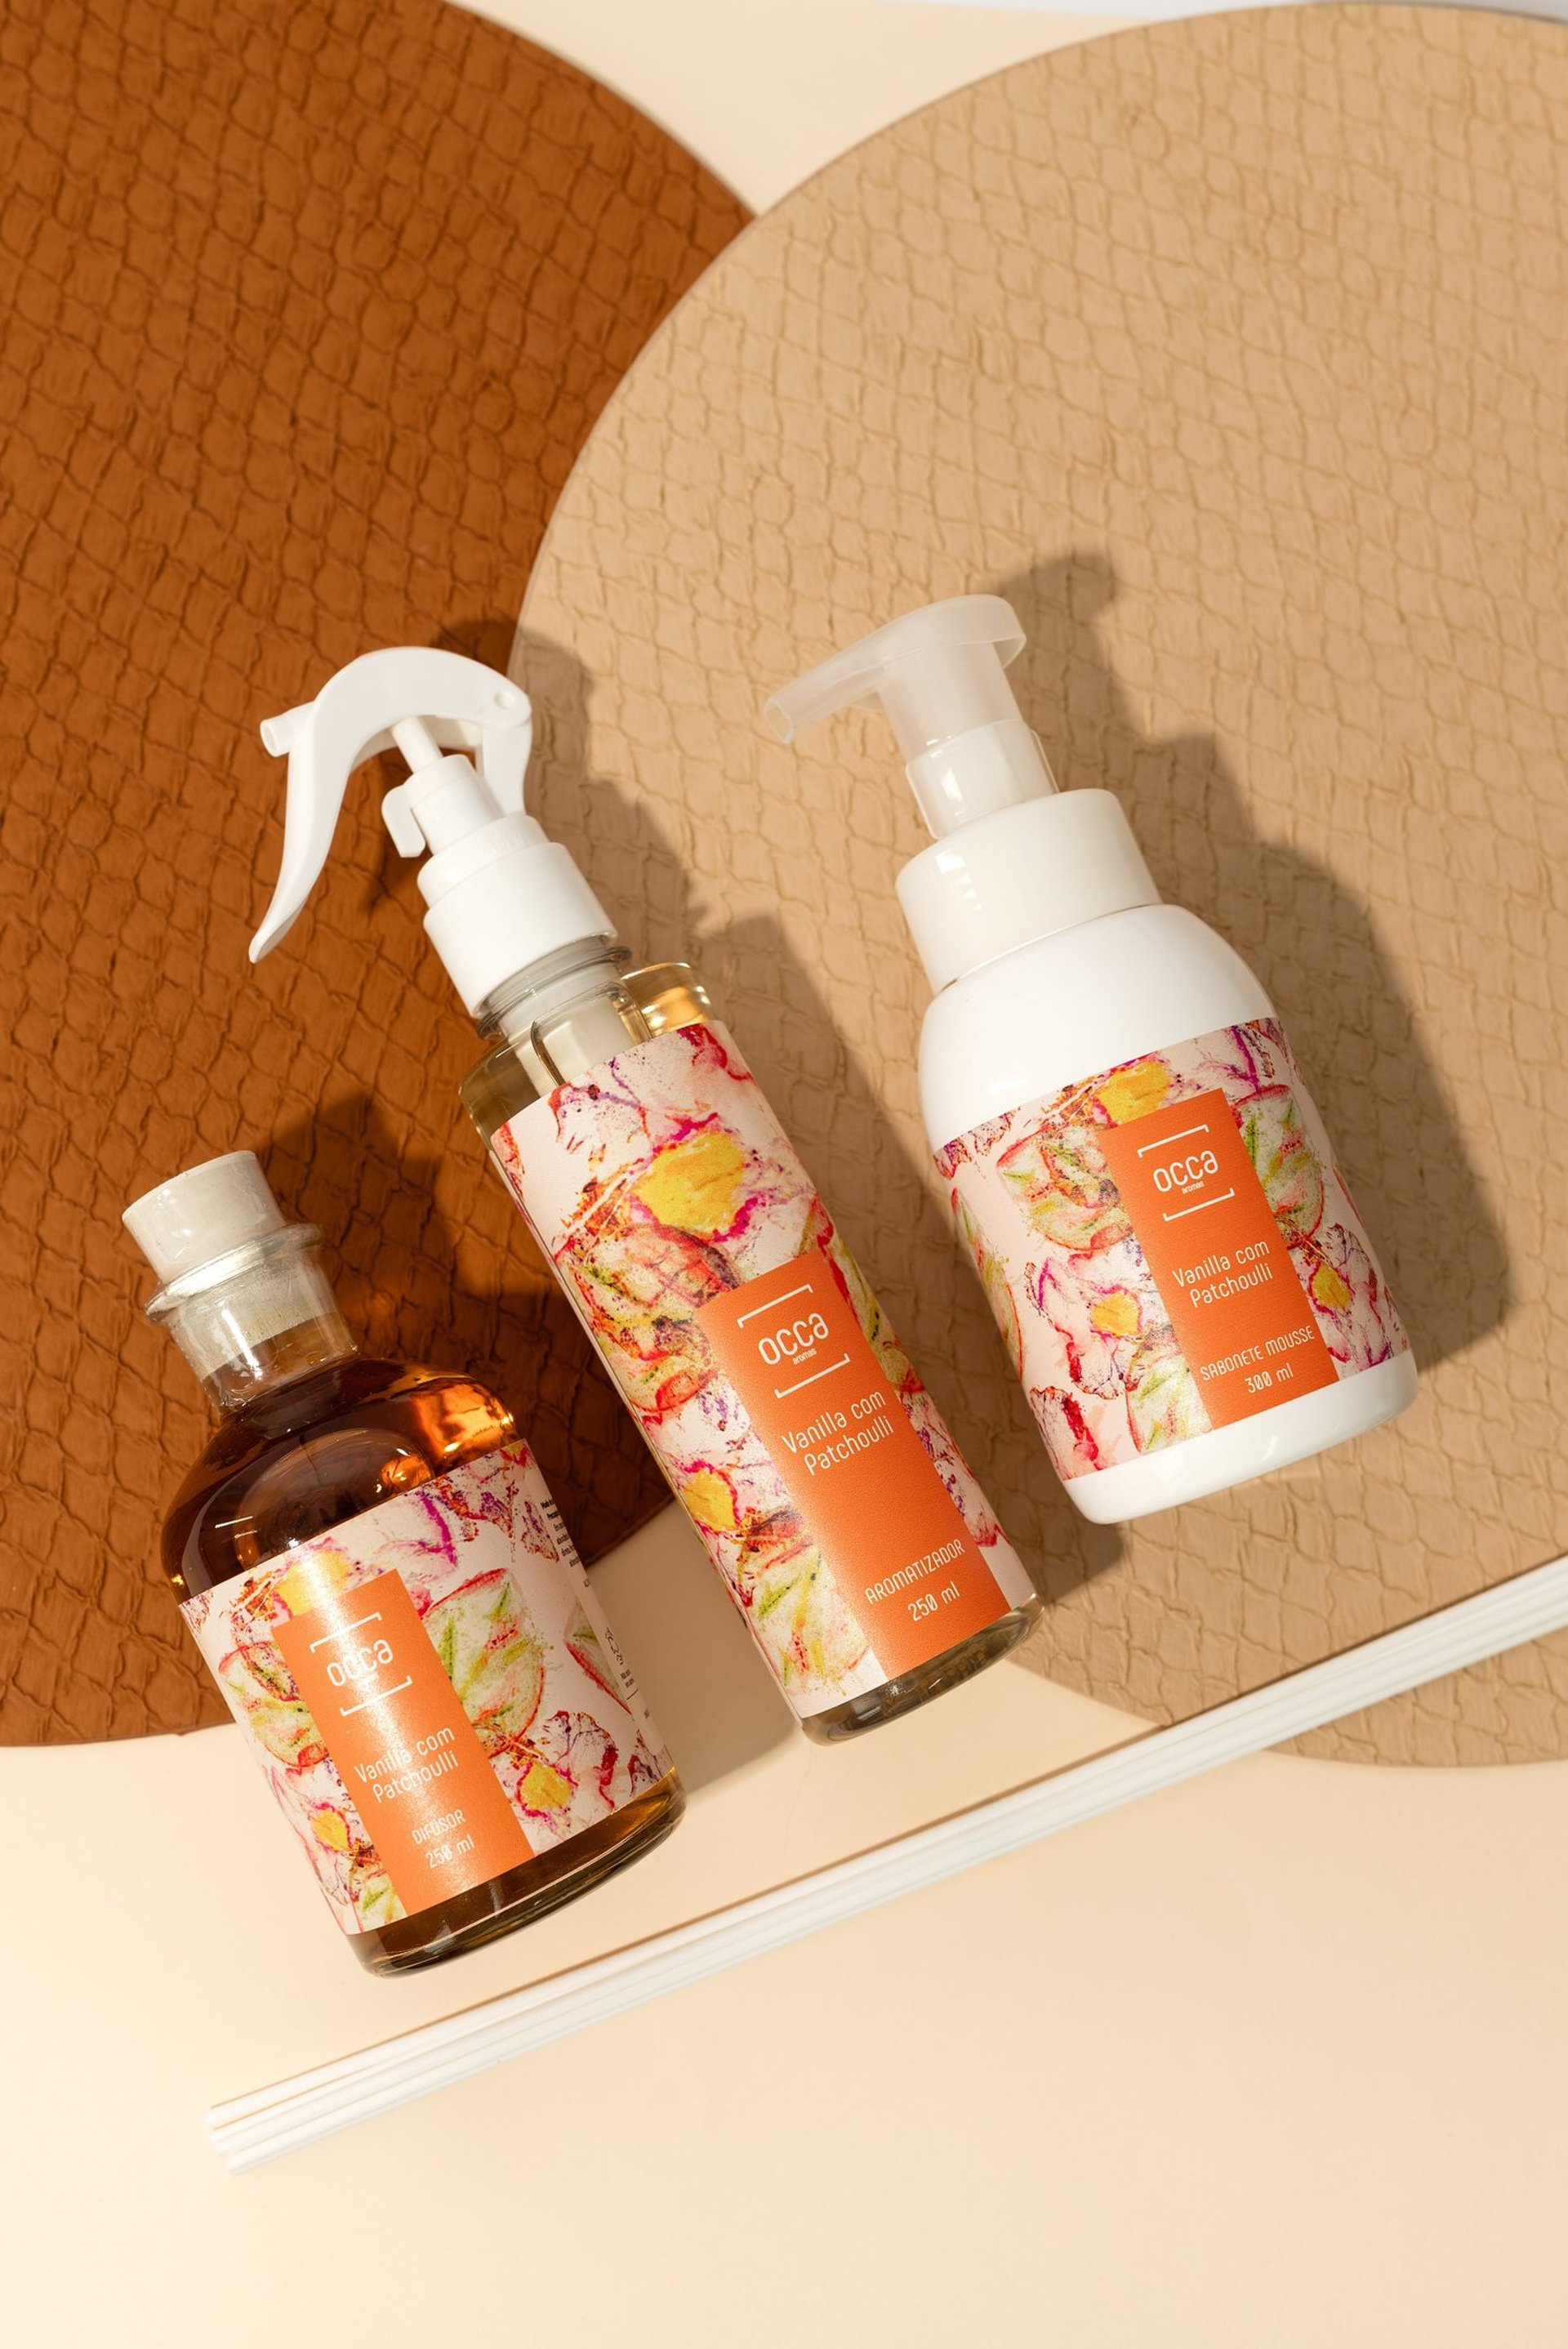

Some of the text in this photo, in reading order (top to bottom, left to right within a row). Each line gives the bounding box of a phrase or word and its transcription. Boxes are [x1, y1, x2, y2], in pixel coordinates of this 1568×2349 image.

[1153, 1150, 1218, 1192] occa
[1172, 1240, 1270, 1288] Vanilla com
[1190, 1263, 1273, 1308] Patchoulli
[758, 1313, 829, 1365] occa
[1200, 1326, 1316, 1381] SABONETE MOUSSE
[1245, 1362, 1294, 1393] 300 ml
[782, 1390, 886, 1454] Vanilla com
[804, 1415, 893, 1476] Patchoulli
[865, 1539, 965, 1605] AROMATIZADOR
[907, 1581, 960, 1621] 250 ml
[327, 1639, 394, 1687] occa
[354, 1727, 455, 1783] Vanilla com
[373, 1749, 458, 1803] Patchoulli
[412, 1809, 466, 1844] DIFUSOR
[425, 1834, 474, 1868] 250 ml
